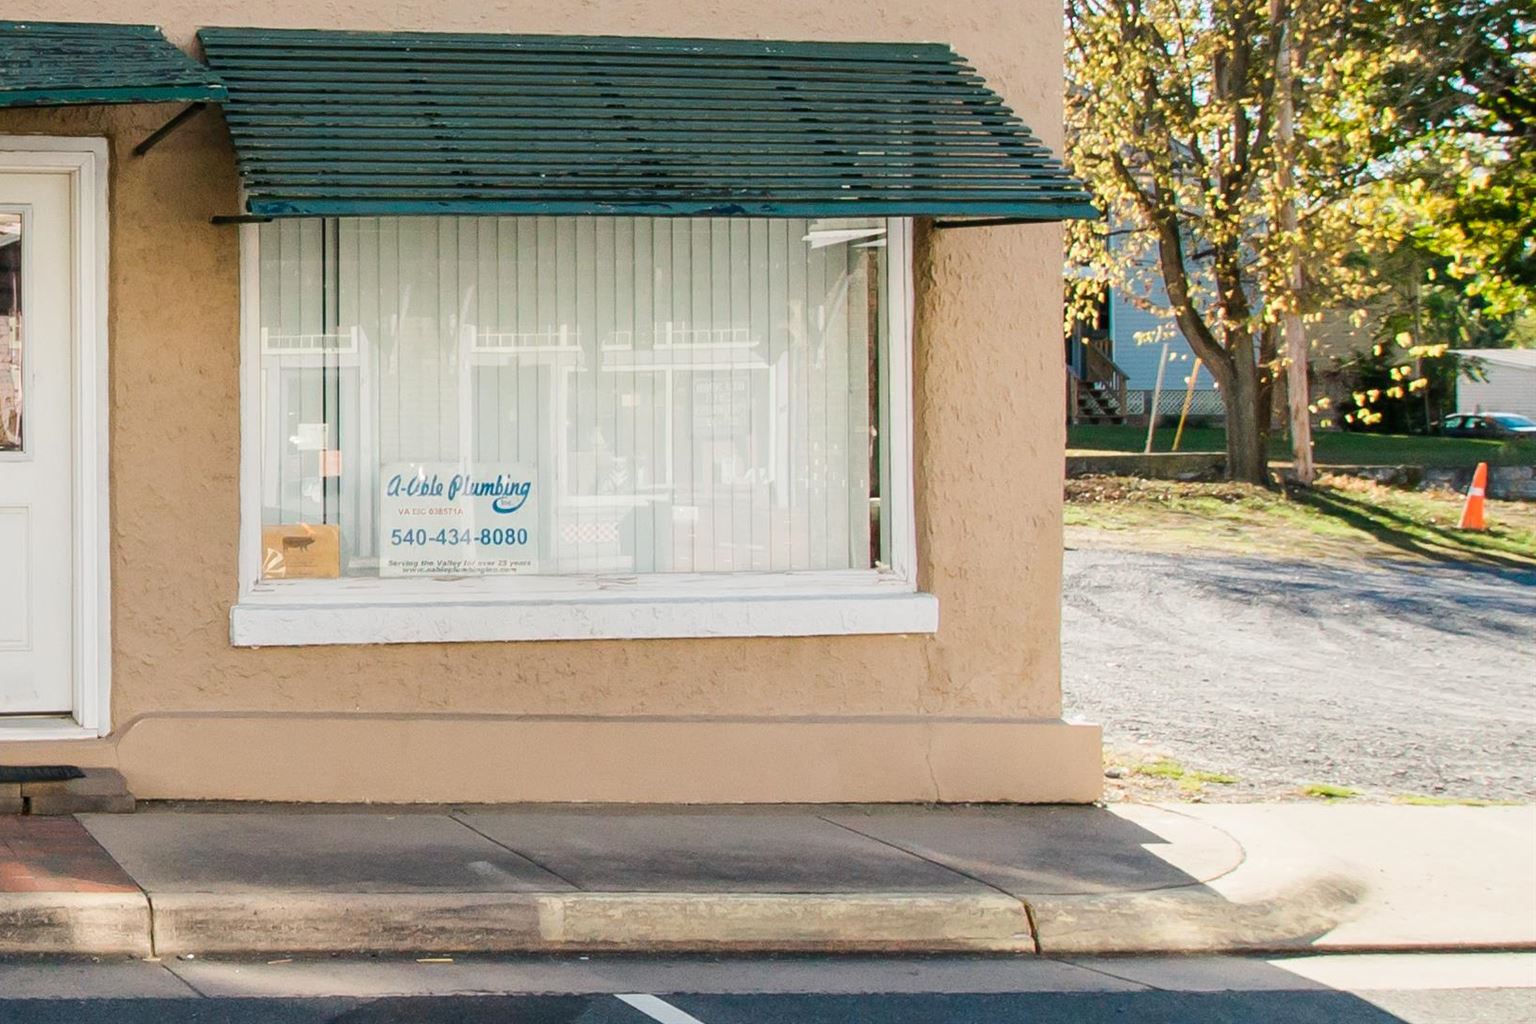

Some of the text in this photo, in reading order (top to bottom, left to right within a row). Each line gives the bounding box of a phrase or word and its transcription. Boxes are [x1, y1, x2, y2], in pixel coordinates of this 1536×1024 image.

[448, 474, 532, 514] Plumbing
[391, 528, 528, 545] 540-434-8080
[388, 560, 418, 568] Serving
[437, 560, 461, 568] Valley
